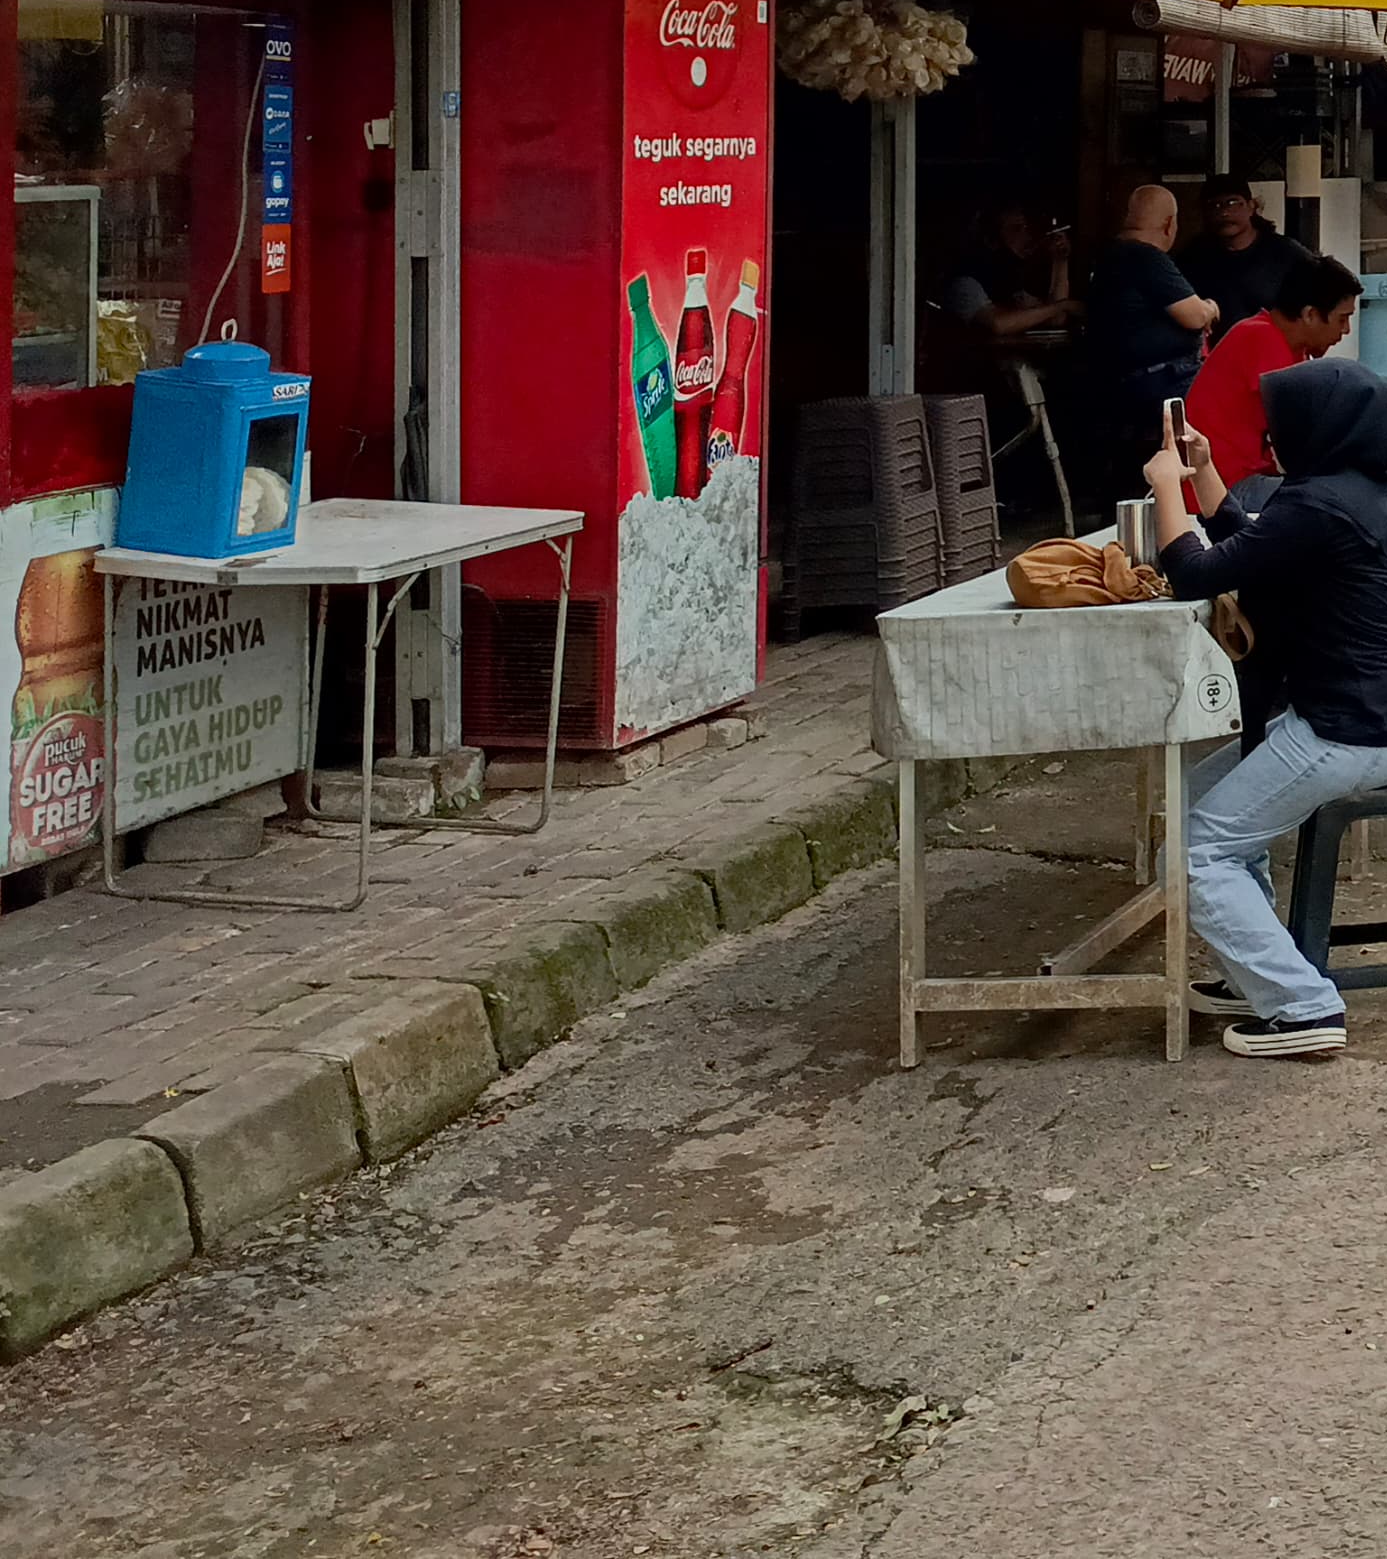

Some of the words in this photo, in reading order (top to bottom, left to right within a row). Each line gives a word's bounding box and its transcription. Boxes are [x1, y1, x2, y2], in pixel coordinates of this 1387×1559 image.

[266, 40, 291, 56] OVO
[634, 132, 682, 162] teguk
[686, 137, 756, 161] segarnya
[659, 180, 732, 208] sekarang
[266, 241, 286, 255] Link
[136, 589, 232, 640] NIKMAT
[136, 617, 265, 678] MANISNYA
[135, 674, 223, 727] UNTUK
[1207, 679, 1221, 707] 18+
[45, 731, 87, 767] pucuk
[134, 719, 201, 764] GAYA
[208, 694, 283, 744] HIDUP
[20, 757, 105, 808] SUGAR
[133, 739, 252, 804] SEHATMU
[33, 791, 93, 837] FREE
